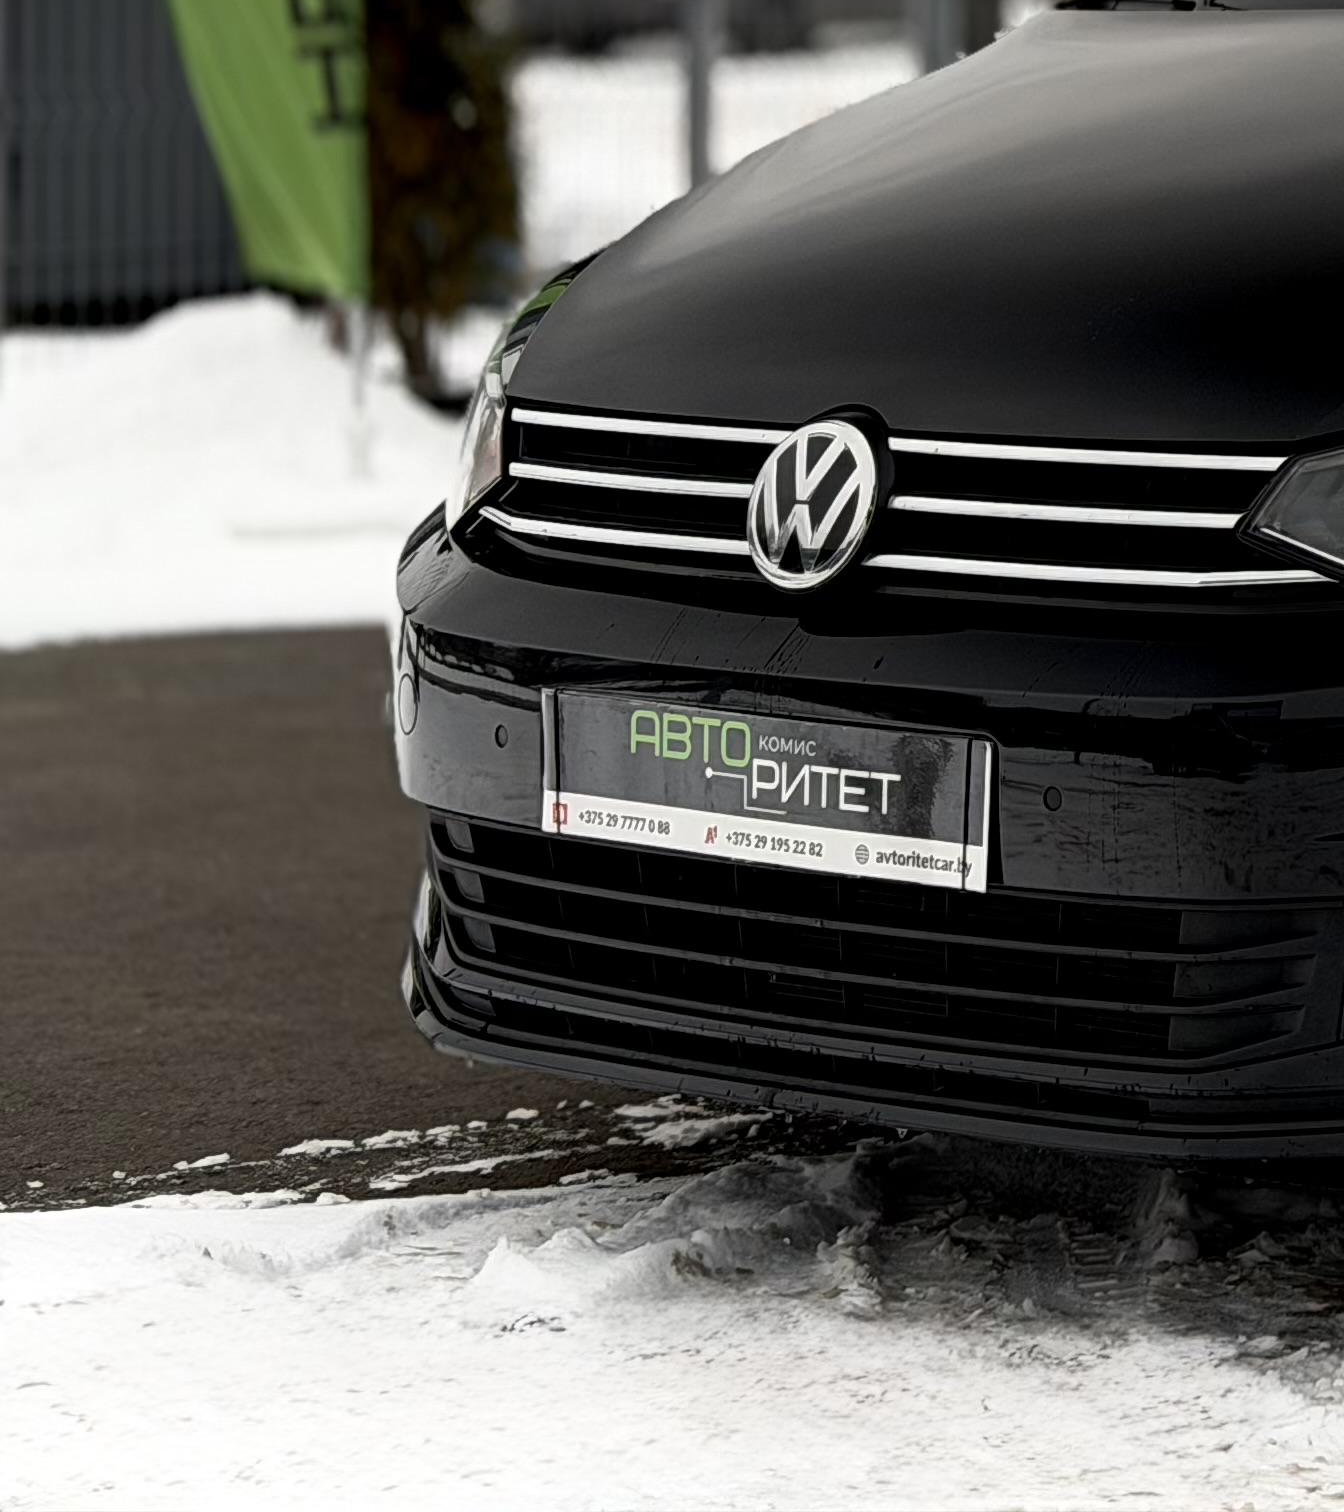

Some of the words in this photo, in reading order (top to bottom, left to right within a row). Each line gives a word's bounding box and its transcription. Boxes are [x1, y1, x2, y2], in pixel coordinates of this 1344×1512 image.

[630, 709, 751, 768] АВТО
[758, 734, 817, 757] КОМИС
[752, 757, 902, 815] РИТЕТ
[578, 809, 604, 826] +375
[605, 812, 619, 828] 29
[620, 814, 647, 832] 7777
[648, 818, 656, 834] 0
[657, 819, 671, 836] 88
[725, 830, 752, 848] +375
[753, 833, 768, 850] 29
[770, 836, 791, 853] 195
[792, 839, 807, 856] 22
[808, 841, 823, 858] 82
[875, 849, 973, 878] avtoritetcar.by
